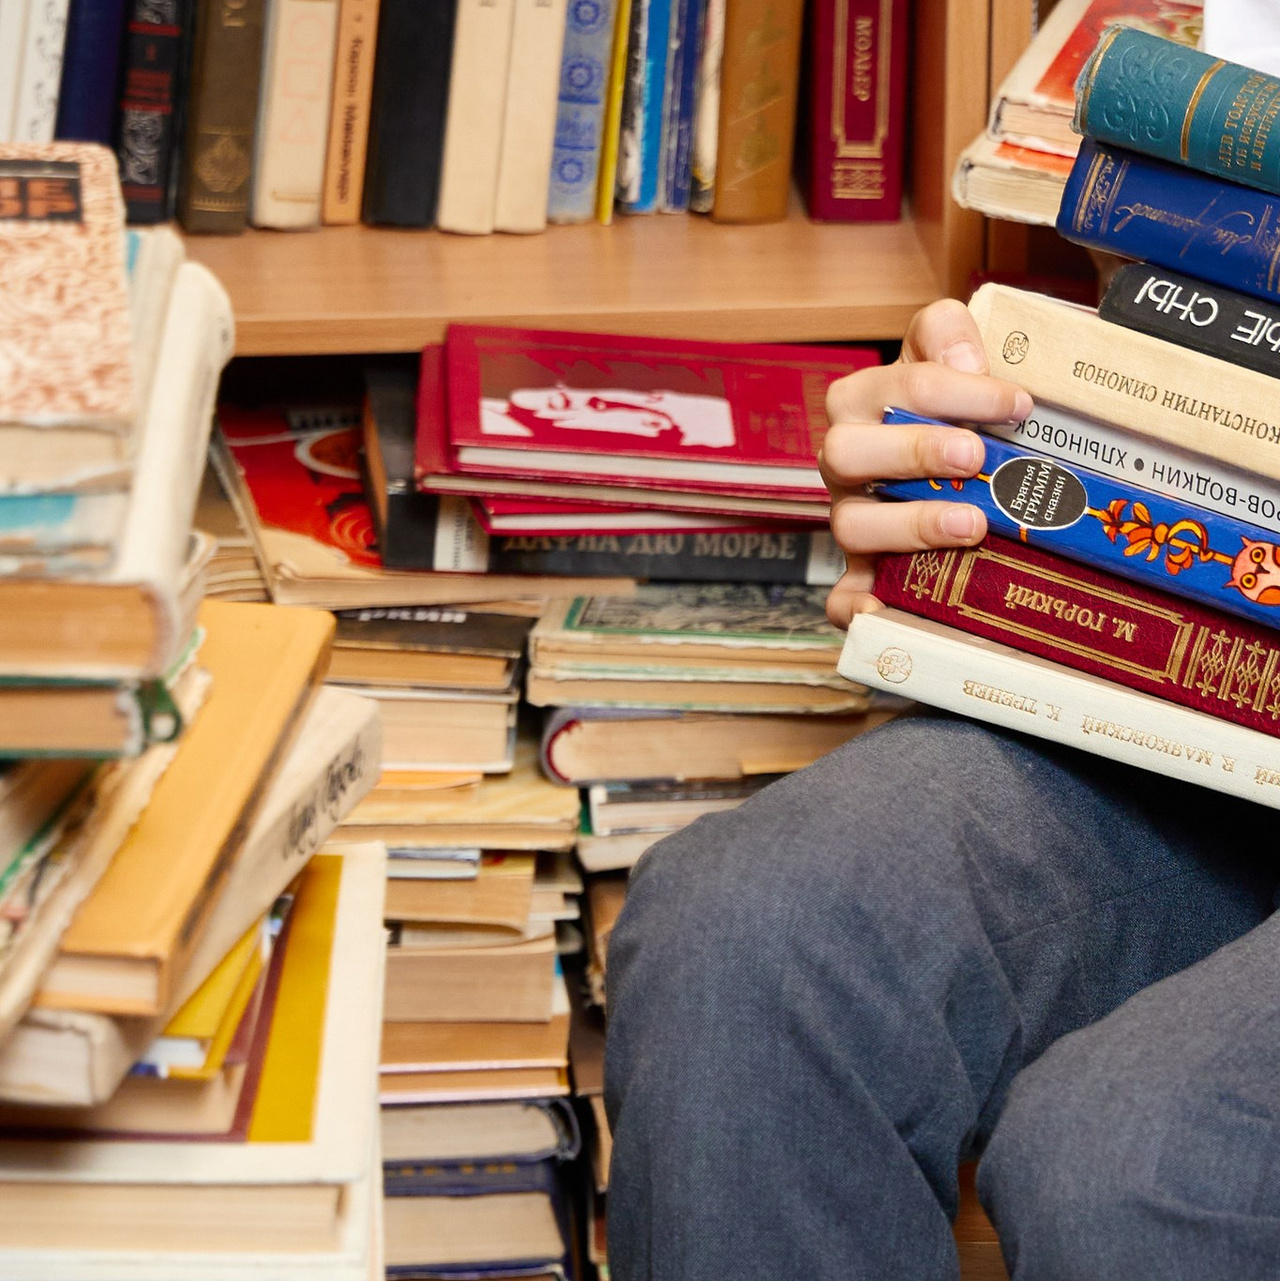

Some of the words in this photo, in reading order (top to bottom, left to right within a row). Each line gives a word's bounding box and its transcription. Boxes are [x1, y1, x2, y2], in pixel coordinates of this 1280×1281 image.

[853, 18, 871, 101] МОЛЬЕР
[1225, 73, 1266, 129] ТОЛСТОЙ
[1219, 134, 1234, 168] ЛЕВ
[1131, 272, 1222, 331] СНЫ
[1070, 358, 1159, 403] СИМОНОВ
[1008, 462, 1038, 512] Братья
[1020, 461, 1055, 523] ГРИММ
[1039, 473, 1068, 522] сказки
[694, 528, 798, 562] МОРЬЕ
[1000, 580, 1108, 633] ГОРЬКИЙ
[1107, 616, 1138, 642] М.
[959, 675, 1041, 717] ТРЕНЕВ
[1076, 710, 1215, 771] МАЯКОВСКИЙ
